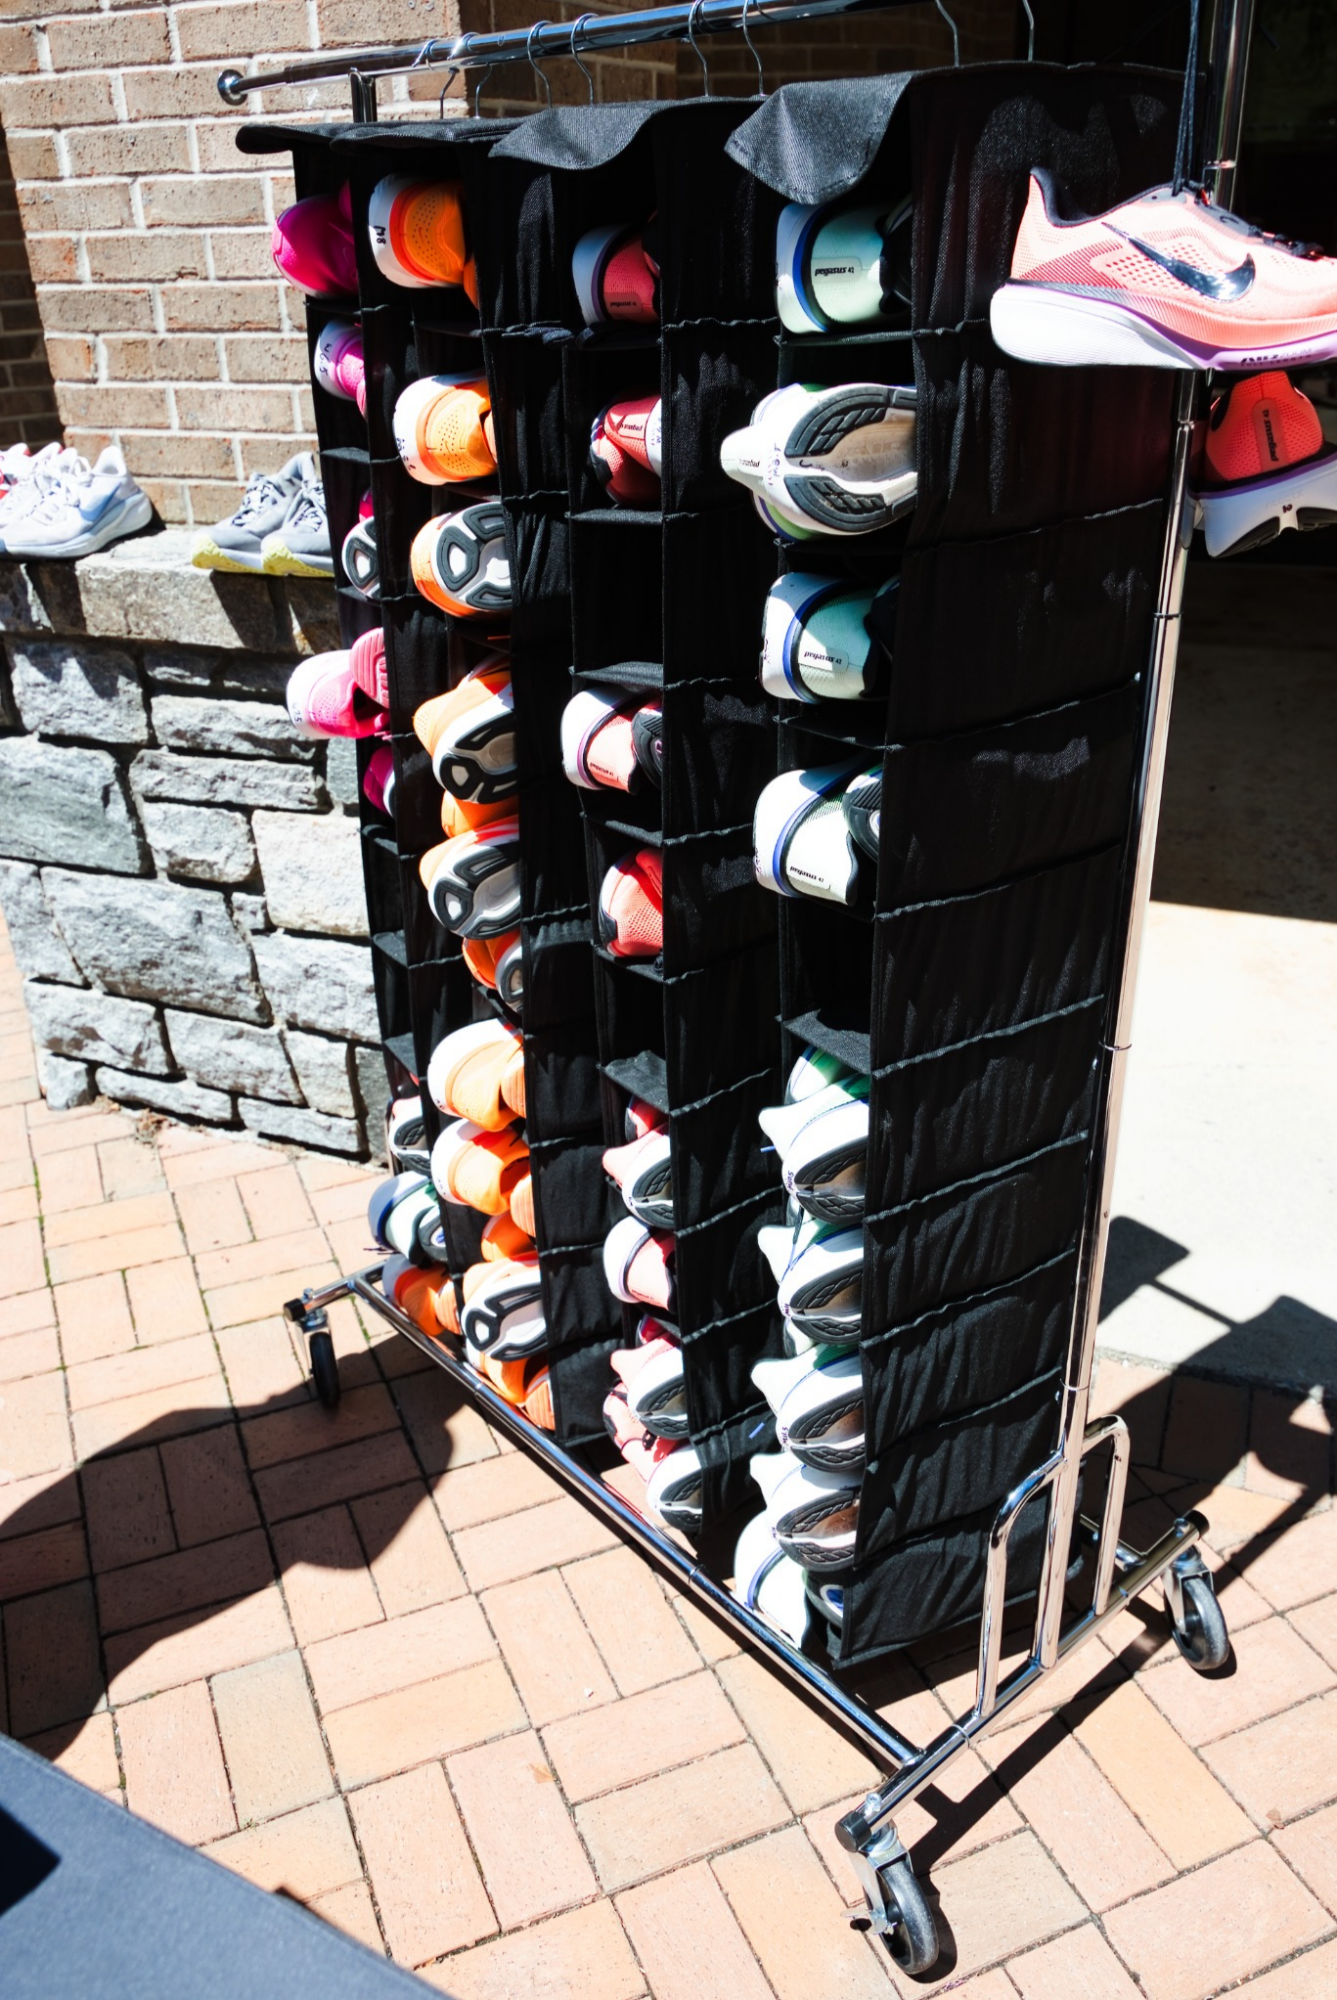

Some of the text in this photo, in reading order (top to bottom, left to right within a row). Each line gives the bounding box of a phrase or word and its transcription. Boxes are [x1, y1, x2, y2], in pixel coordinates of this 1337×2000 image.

[814, 266, 855, 276] pegasus 42
[1262, 408, 1279, 462] pegasus 42
